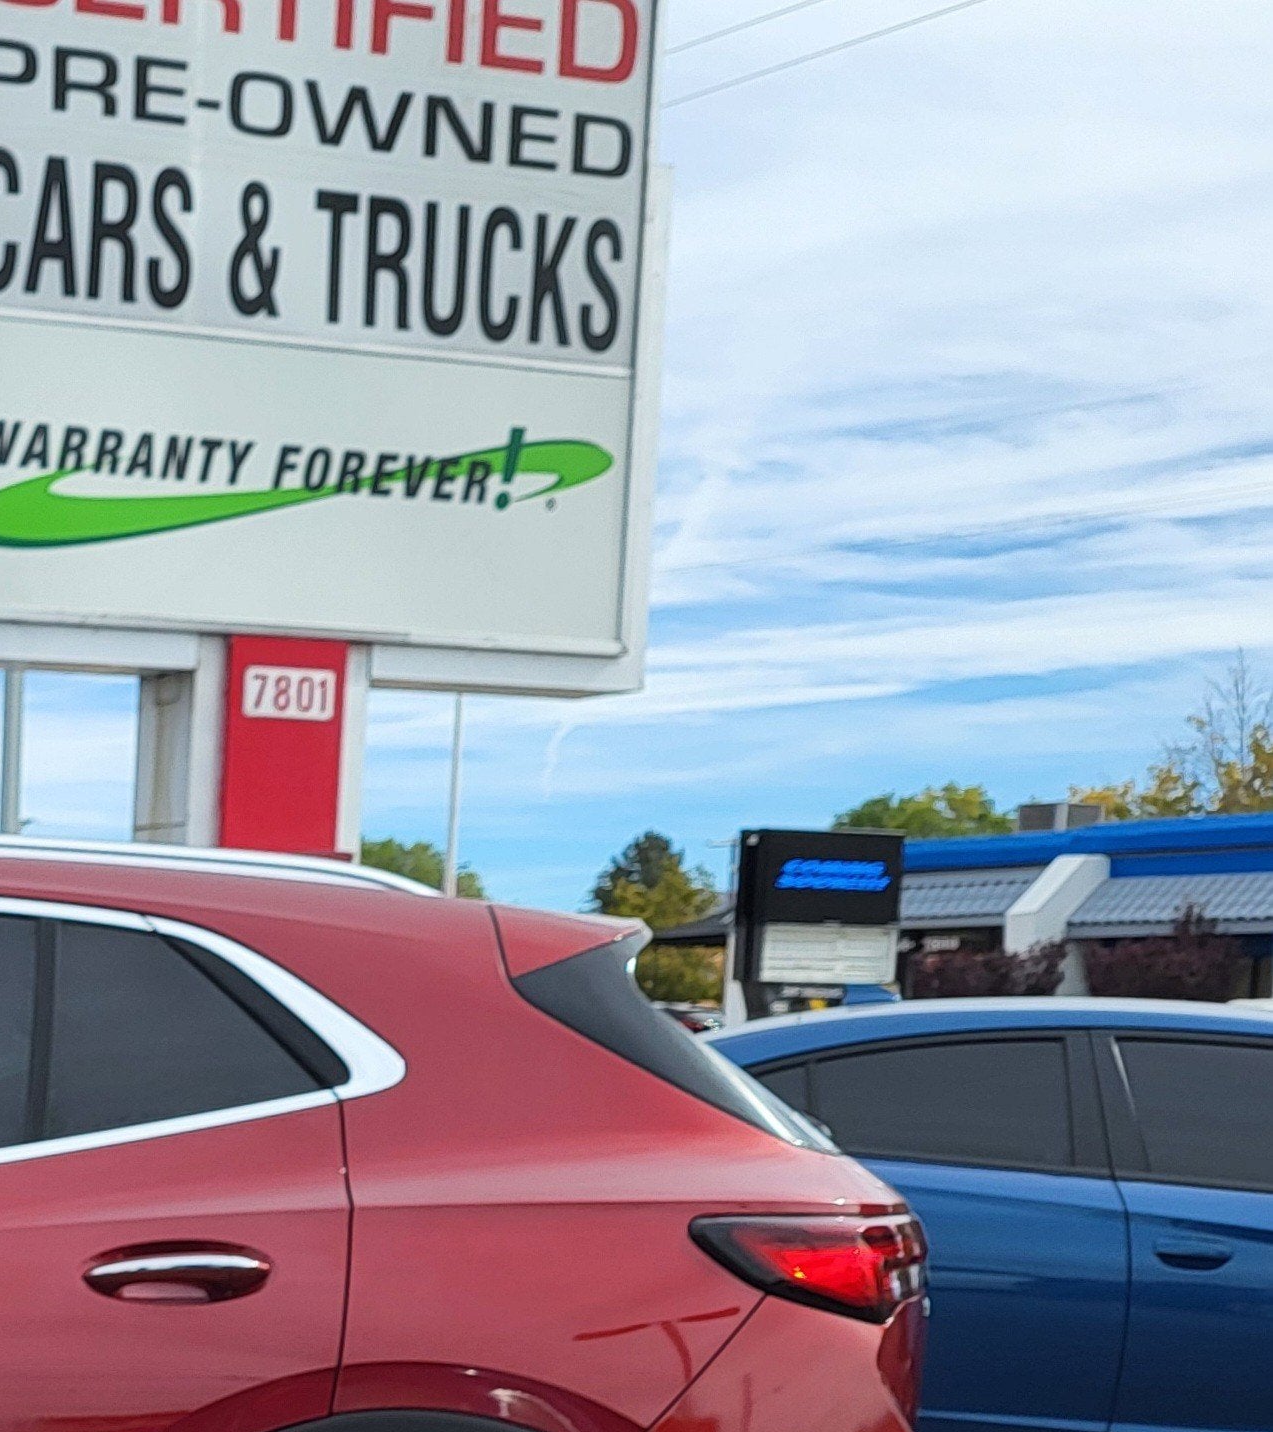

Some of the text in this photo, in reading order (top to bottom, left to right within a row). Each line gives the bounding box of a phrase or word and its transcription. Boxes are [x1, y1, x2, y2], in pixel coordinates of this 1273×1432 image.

[228, 180, 281, 319] &
[315, 188, 625, 355] TRUCKS
[272, 427, 526, 511] FOREVER!
[253, 673, 328, 713] 7801
